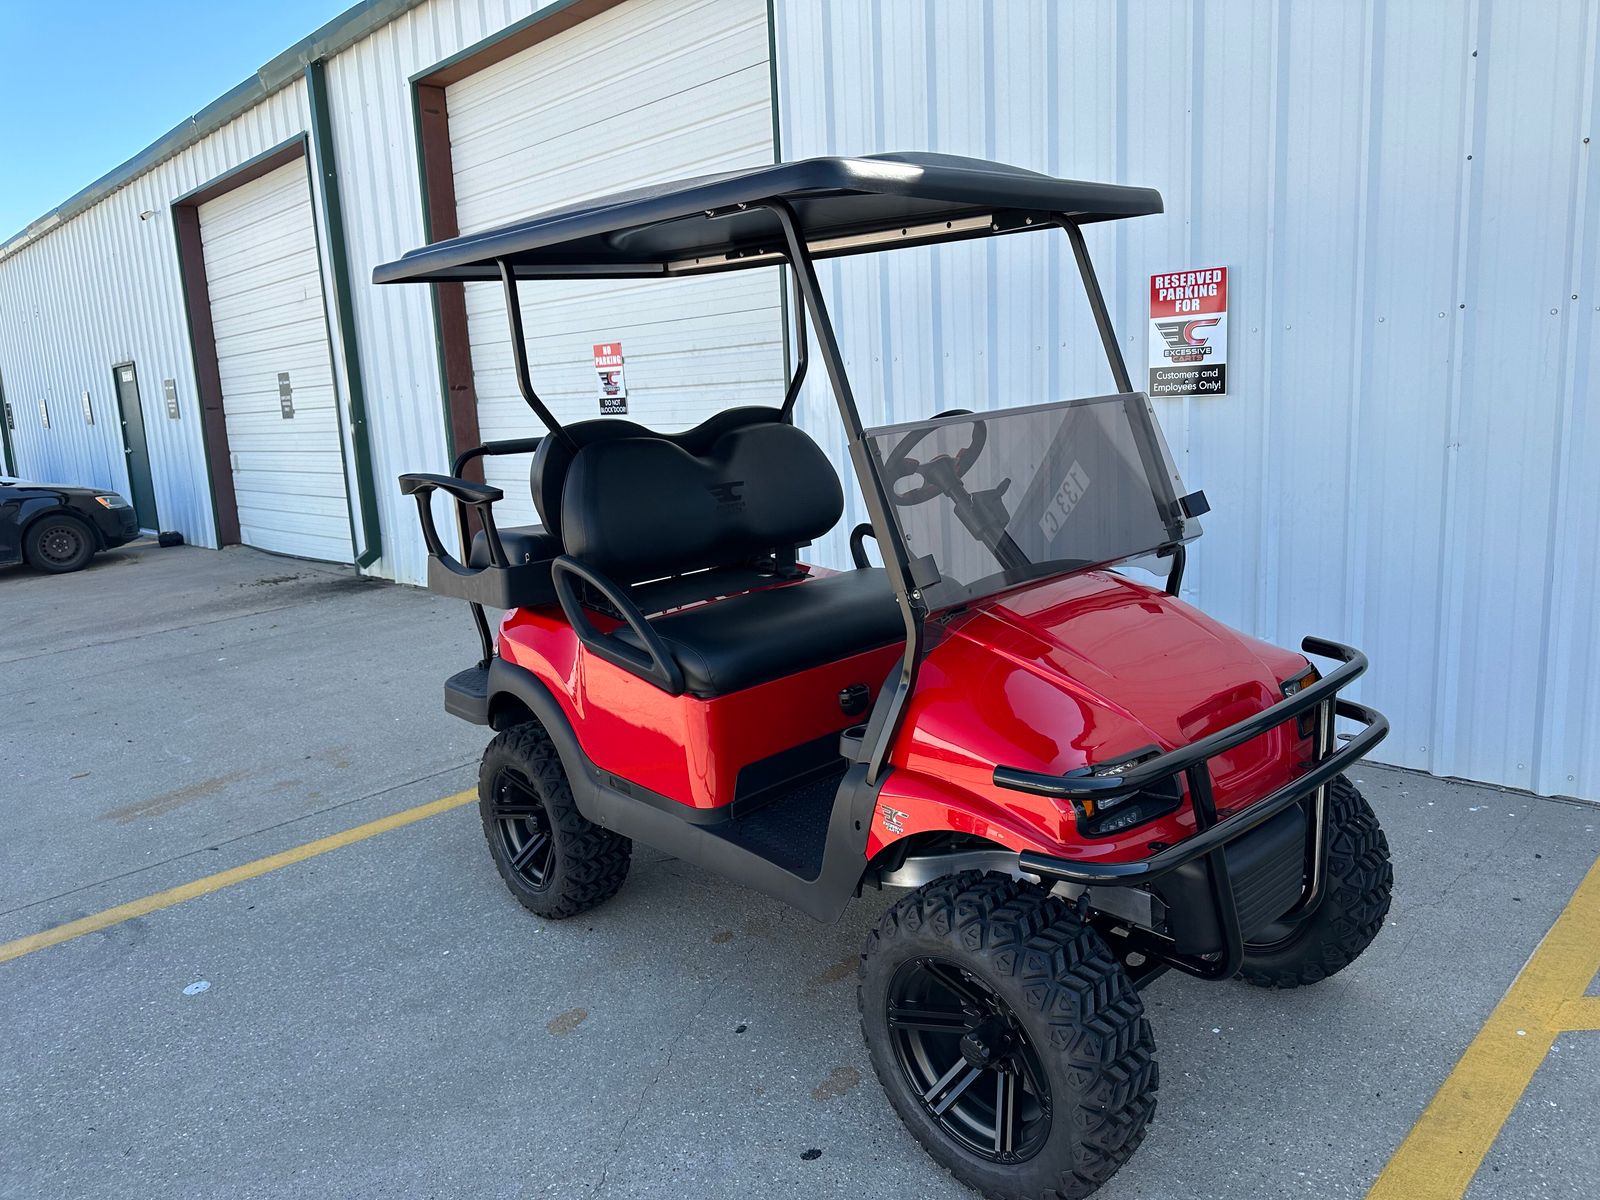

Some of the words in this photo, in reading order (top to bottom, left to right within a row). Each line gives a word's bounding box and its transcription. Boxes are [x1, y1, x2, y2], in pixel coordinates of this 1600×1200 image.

[1155, 270, 1222, 289] RESERVED
[1159, 284, 1217, 301] PARKING
[1175, 299, 1200, 312] FOR
[602, 346, 611, 355] NO
[1164, 347, 1212, 357] EXCESSIVE
[595, 355, 621, 366] PARKING
[1156, 371, 1199, 380] Customers
[1201, 369, 1219, 378] and
[1153, 382, 1197, 393] Employees
[1199, 380, 1222, 391] Only!
